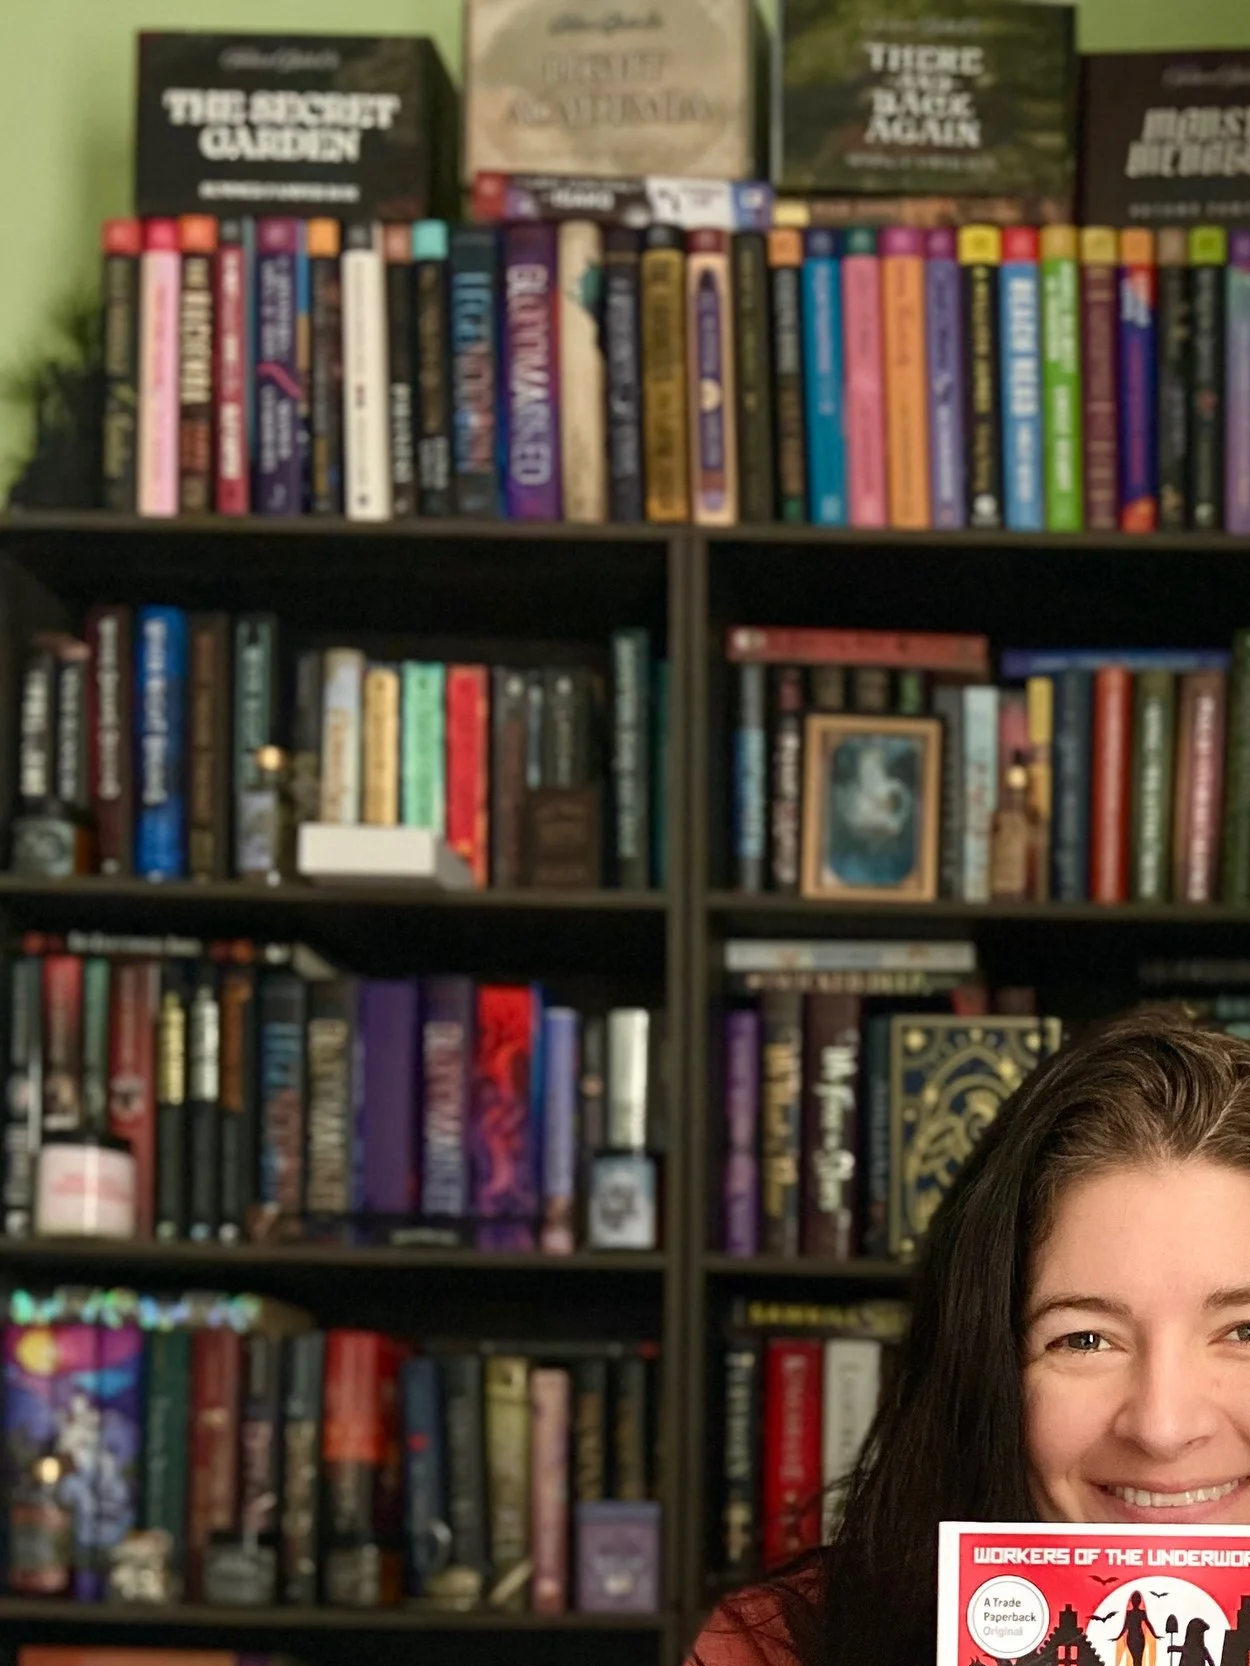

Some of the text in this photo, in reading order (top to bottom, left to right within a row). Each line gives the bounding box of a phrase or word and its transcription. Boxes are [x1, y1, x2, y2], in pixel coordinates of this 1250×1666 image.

[865, 42, 985, 75] THERE
[162, 87, 401, 130] THE SECRET
[868, 88, 975, 120] BACK
[198, 124, 361, 162] GARDEN
[864, 115, 981, 149] AGAIN
[973, 1547, 1070, 1566] WORKERS
[1074, 1547, 1101, 1567] OF
[1105, 1548, 1143, 1567] THE
[983, 1612, 1037, 1625] Paperback
[984, 1597, 1022, 1608] A Trade
[983, 1625, 1023, 1639] Original
